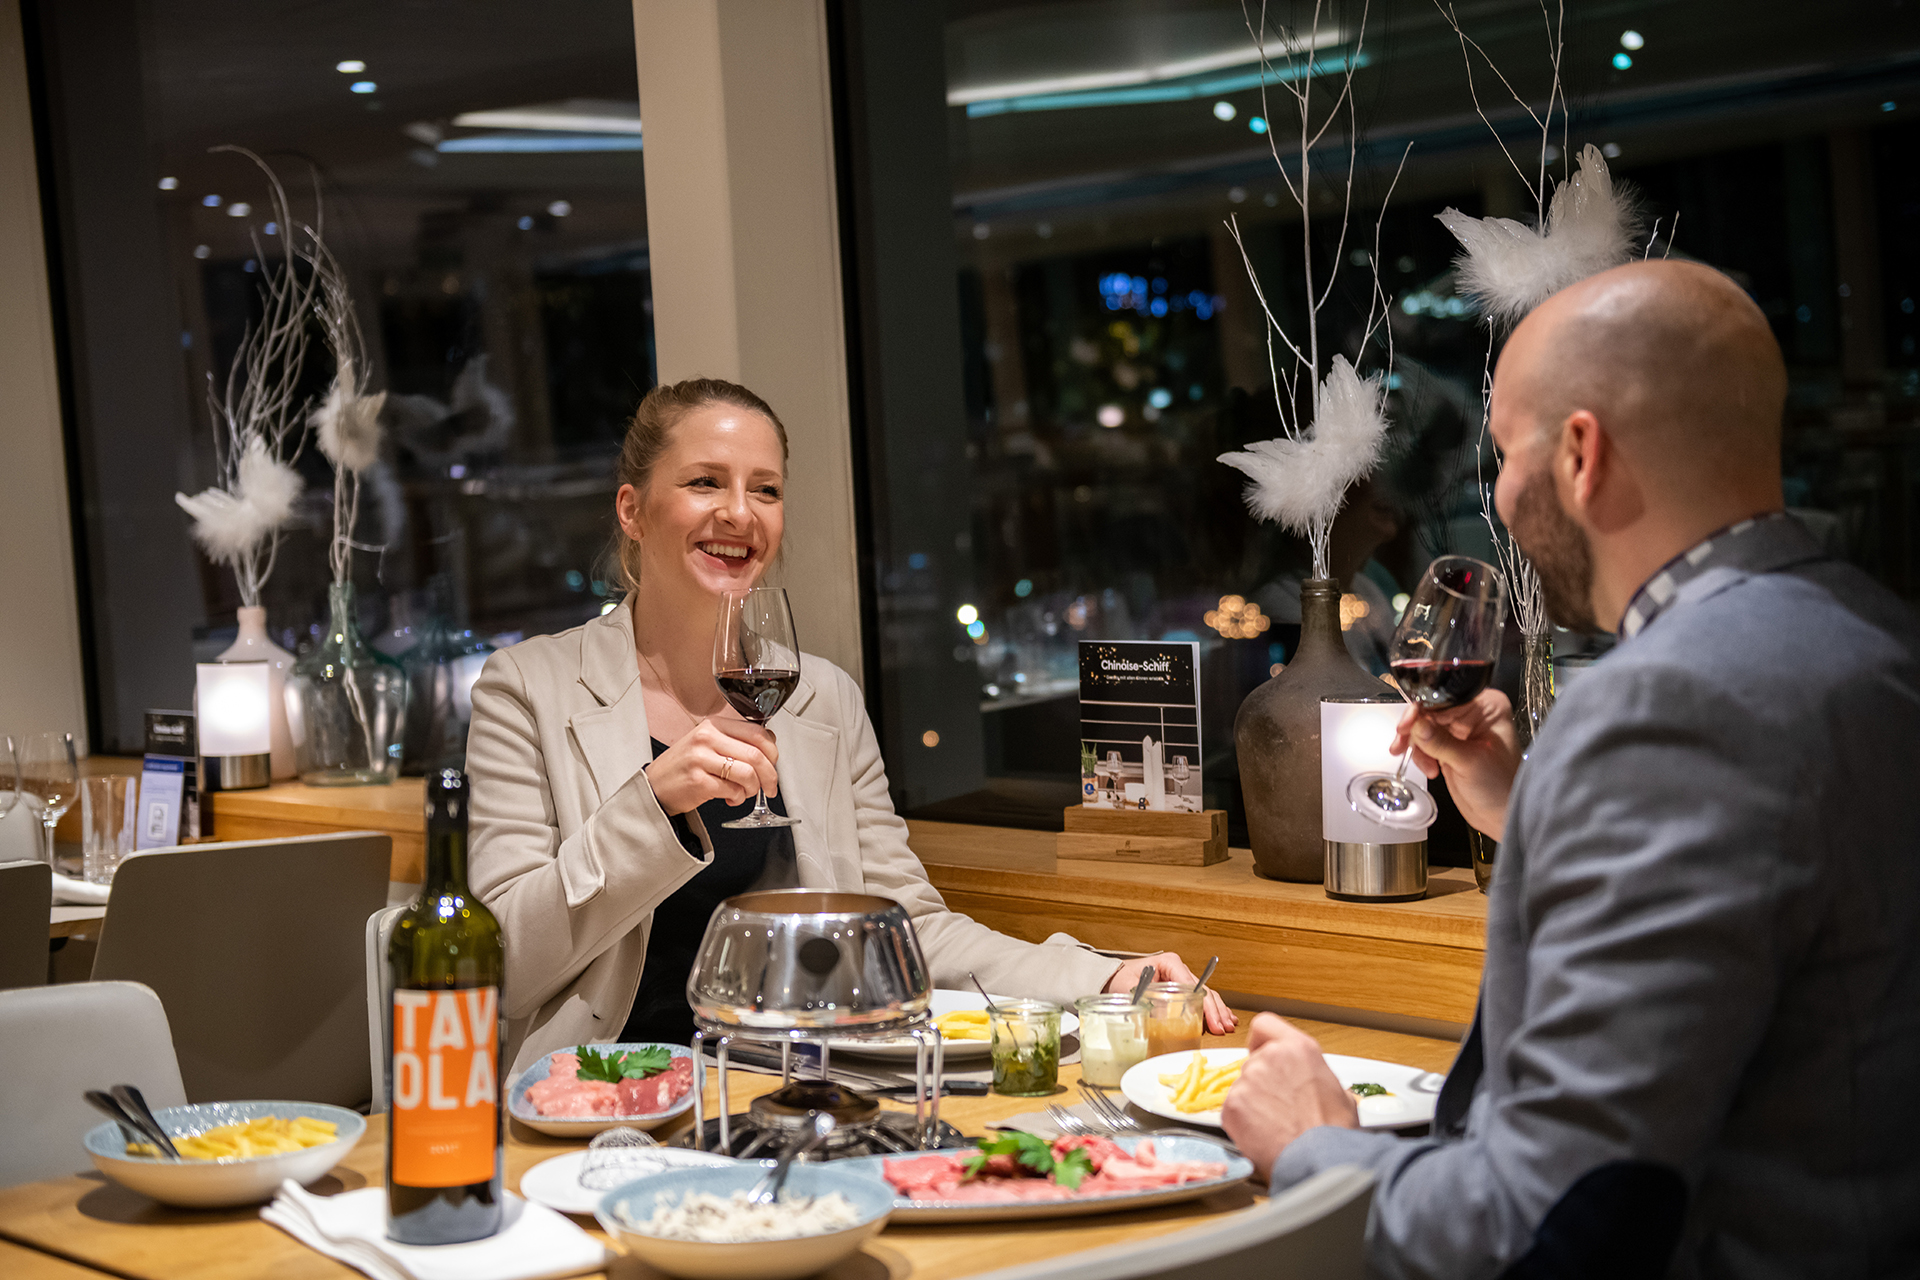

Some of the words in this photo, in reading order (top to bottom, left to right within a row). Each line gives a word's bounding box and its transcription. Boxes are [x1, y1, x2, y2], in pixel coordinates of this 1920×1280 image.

[1101, 659, 1169, 671] Chinoise-Schiff
[393, 985, 498, 1050] TAV
[393, 1050, 498, 1110] OLA
